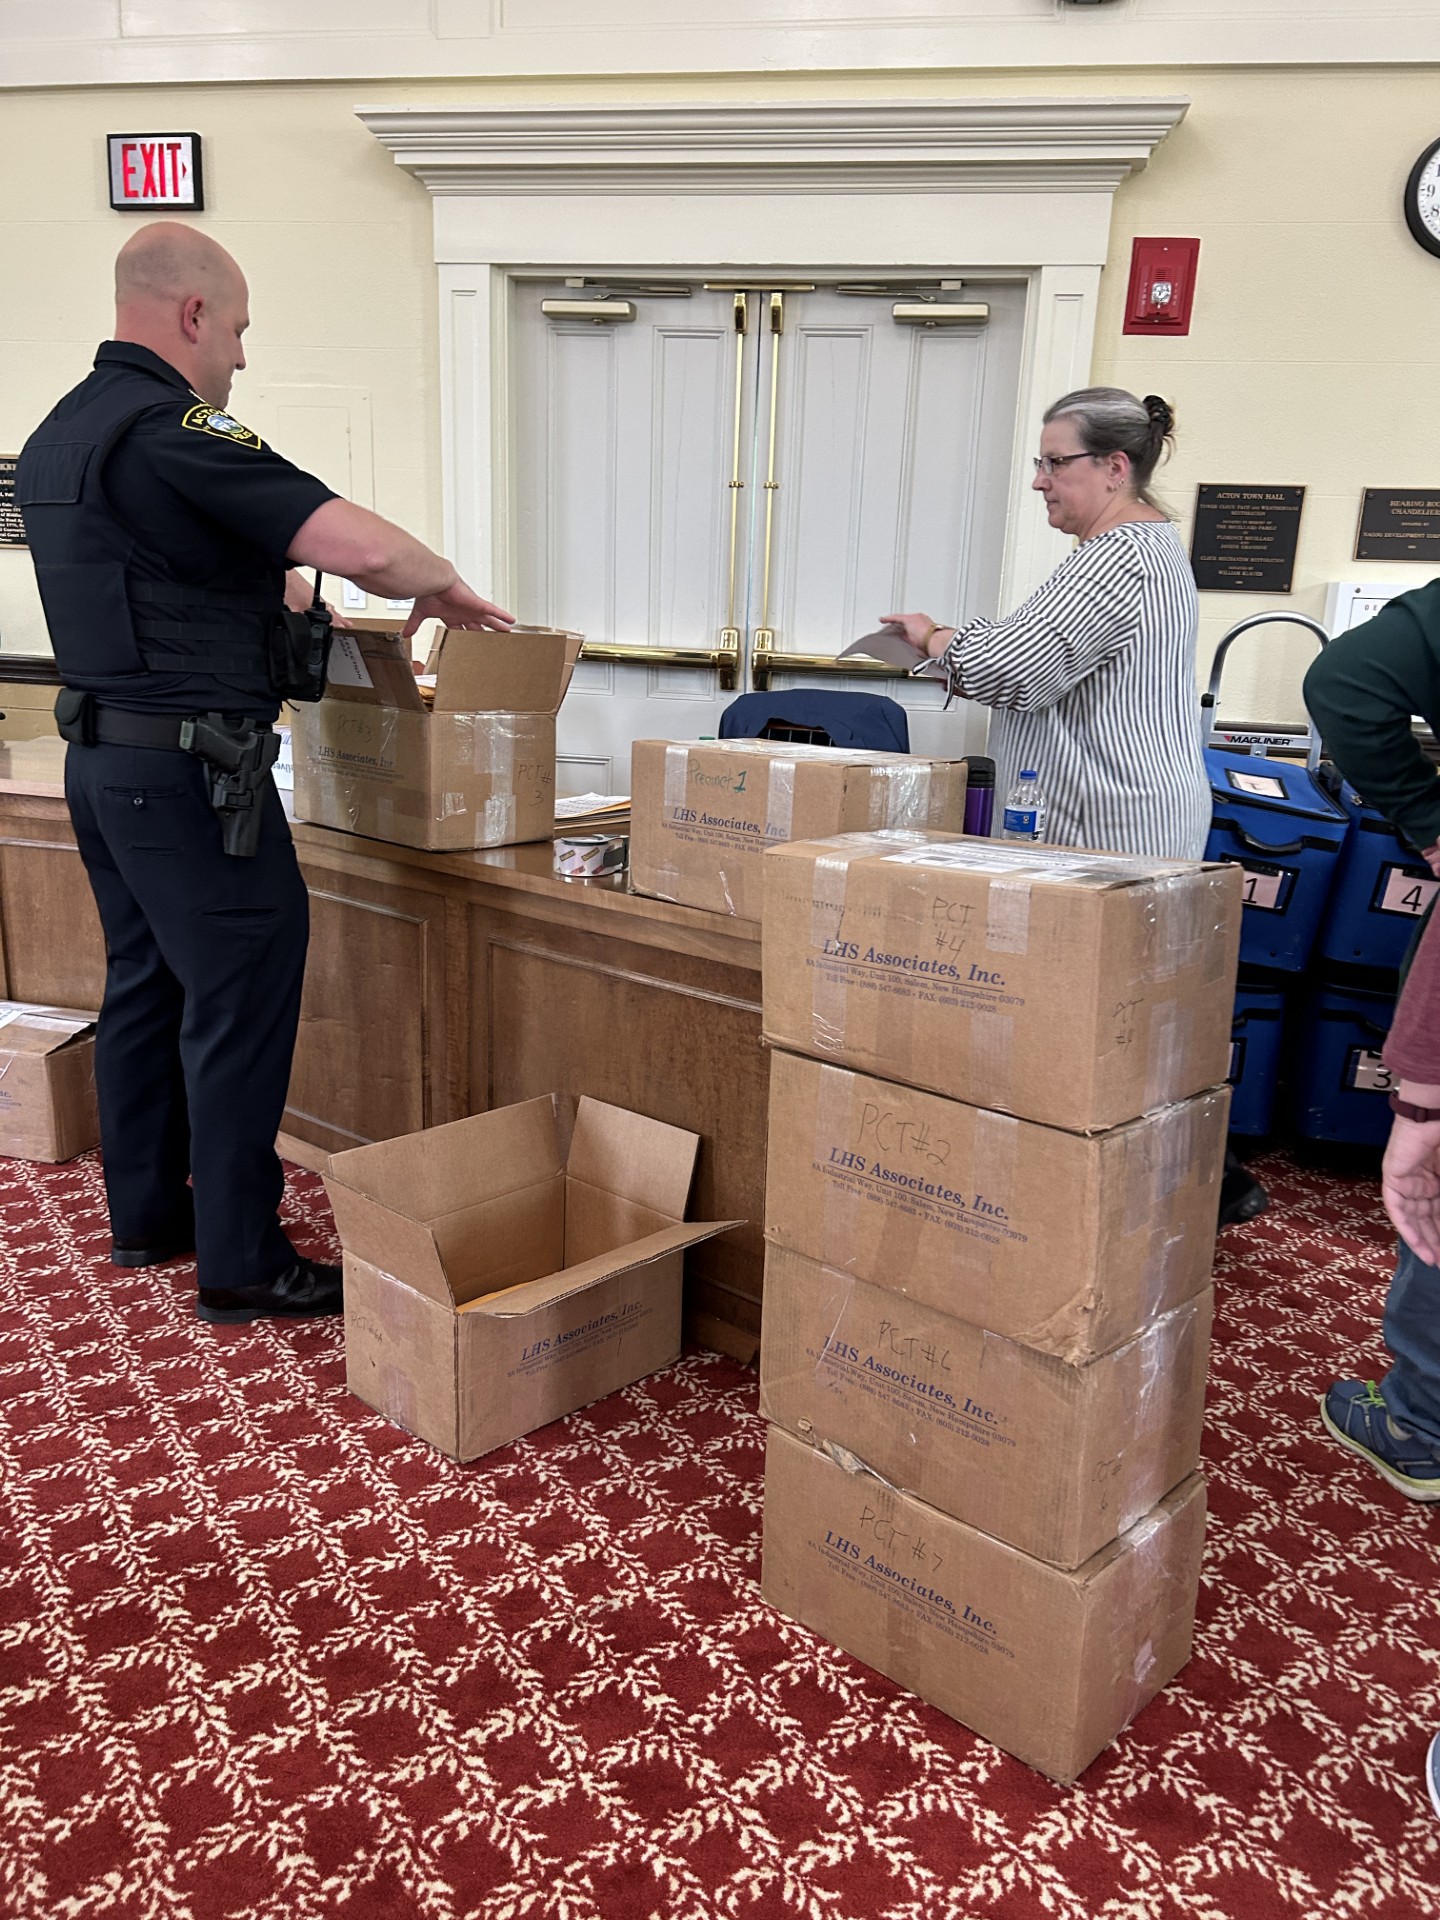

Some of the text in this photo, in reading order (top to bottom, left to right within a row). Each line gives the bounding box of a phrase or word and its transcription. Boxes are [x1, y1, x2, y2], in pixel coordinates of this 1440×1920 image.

[122, 142, 182, 197] EXIT
[1427, 184, 1435, 198] 9
[1431, 204, 1440, 218] 8
[318, 745, 335, 758] LHS
[1229, 735, 1291, 746] MAGLINER
[733, 770, 747, 793] 1
[530, 790, 545, 807] 3
[672, 807, 788, 838] LHS Associates, Inc.
[1241, 877, 1259, 904] 1
[1401, 885, 1423, 912] 4
[932, 896, 976, 928] PCT
[935, 930, 965, 964] #4
[822, 939, 1005, 986] LHS Associates, Inc.
[825, 973, 838, 982] Toll
[932, 982, 949, 992] New
[952, 985, 997, 1001] Hampshire
[1372, 1064, 1392, 1089] 3
[829, 1147, 1009, 1220] LHS Associates, Inc.
[832, 1180, 846, 1190] Toll
[937, 1206, 954, 1218] New
[956, 1213, 1000, 1233] Hampshire
[521, 1338, 550, 1362] LHS
[552, 1312, 618, 1348] Associates,
[621, 1301, 643, 1316] Inc.
[823, 1336, 998, 1425] LHS Associates, Inc.
[826, 1366, 839, 1378] Toll
[929, 1404, 945, 1417] New
[947, 1412, 991, 1437] Hampshire
[825, 1530, 997, 1635] LHS Associates, Inc.
[929, 1607, 946, 1621] New
